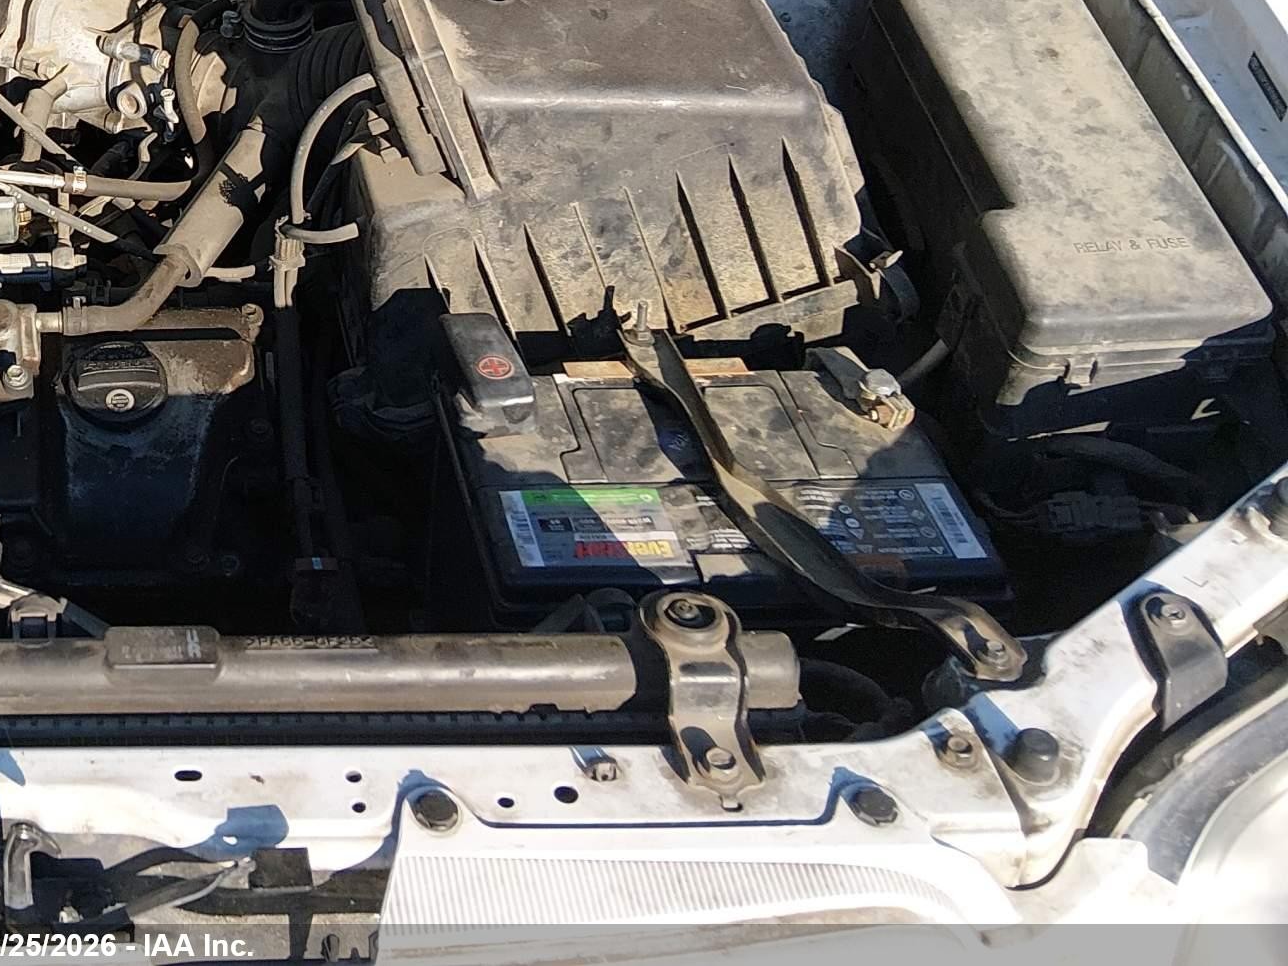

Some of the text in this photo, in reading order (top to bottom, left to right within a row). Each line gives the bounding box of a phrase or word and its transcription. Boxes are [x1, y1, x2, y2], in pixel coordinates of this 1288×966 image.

[1073, 236, 1191, 254] RELAY & FUSE
